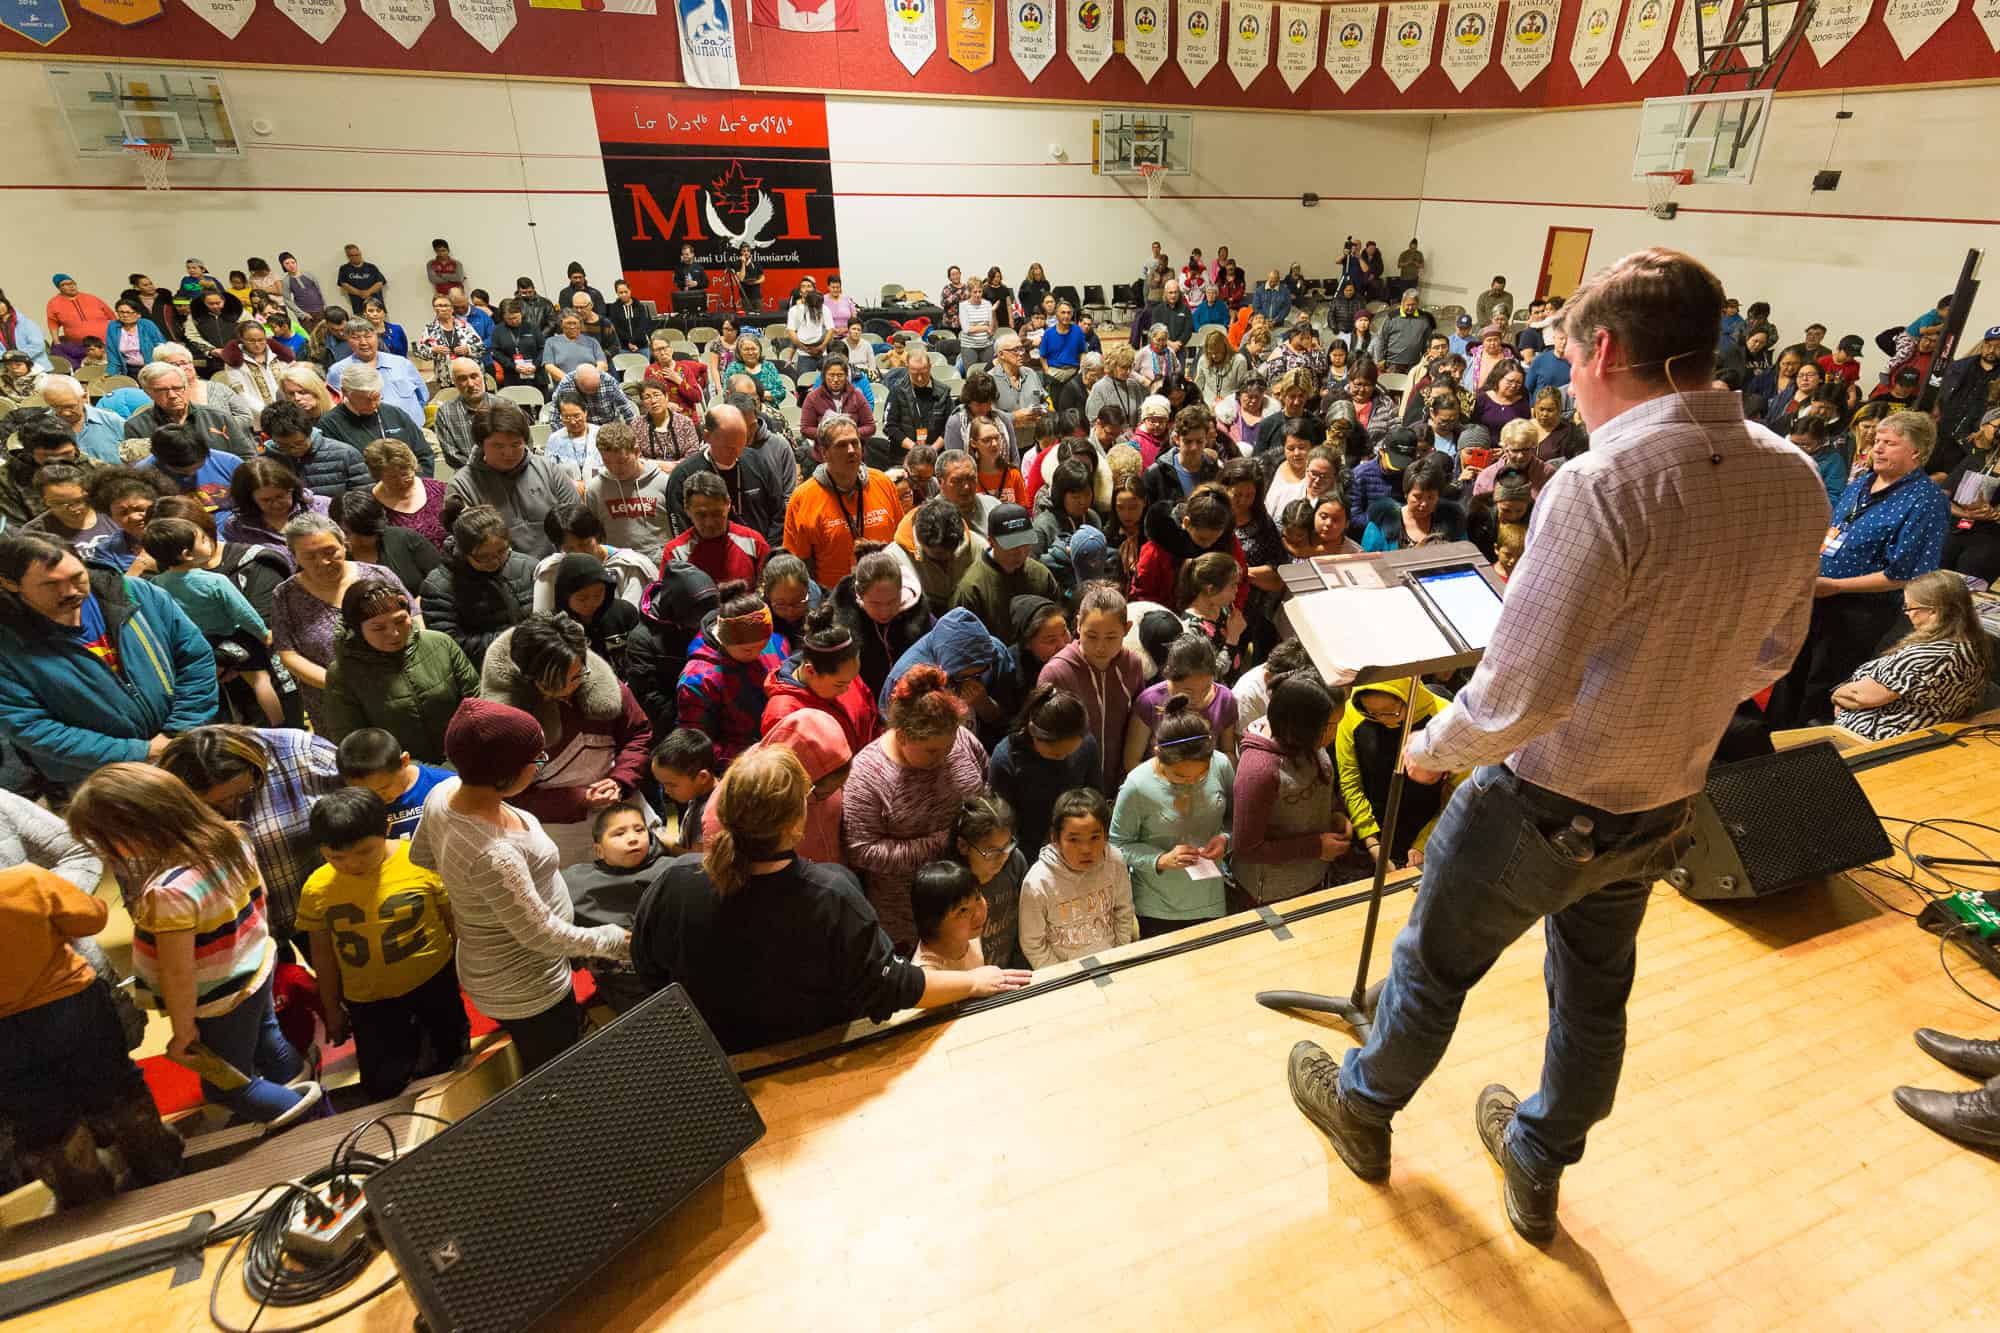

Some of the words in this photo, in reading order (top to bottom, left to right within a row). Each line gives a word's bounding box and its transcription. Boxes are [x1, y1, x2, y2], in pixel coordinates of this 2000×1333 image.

[211, 3, 235, 11] BOYS
[302, 7, 325, 15] BOYS
[1834, 16, 1860, 26] UNDER
[324, 893, 426, 969] 62
